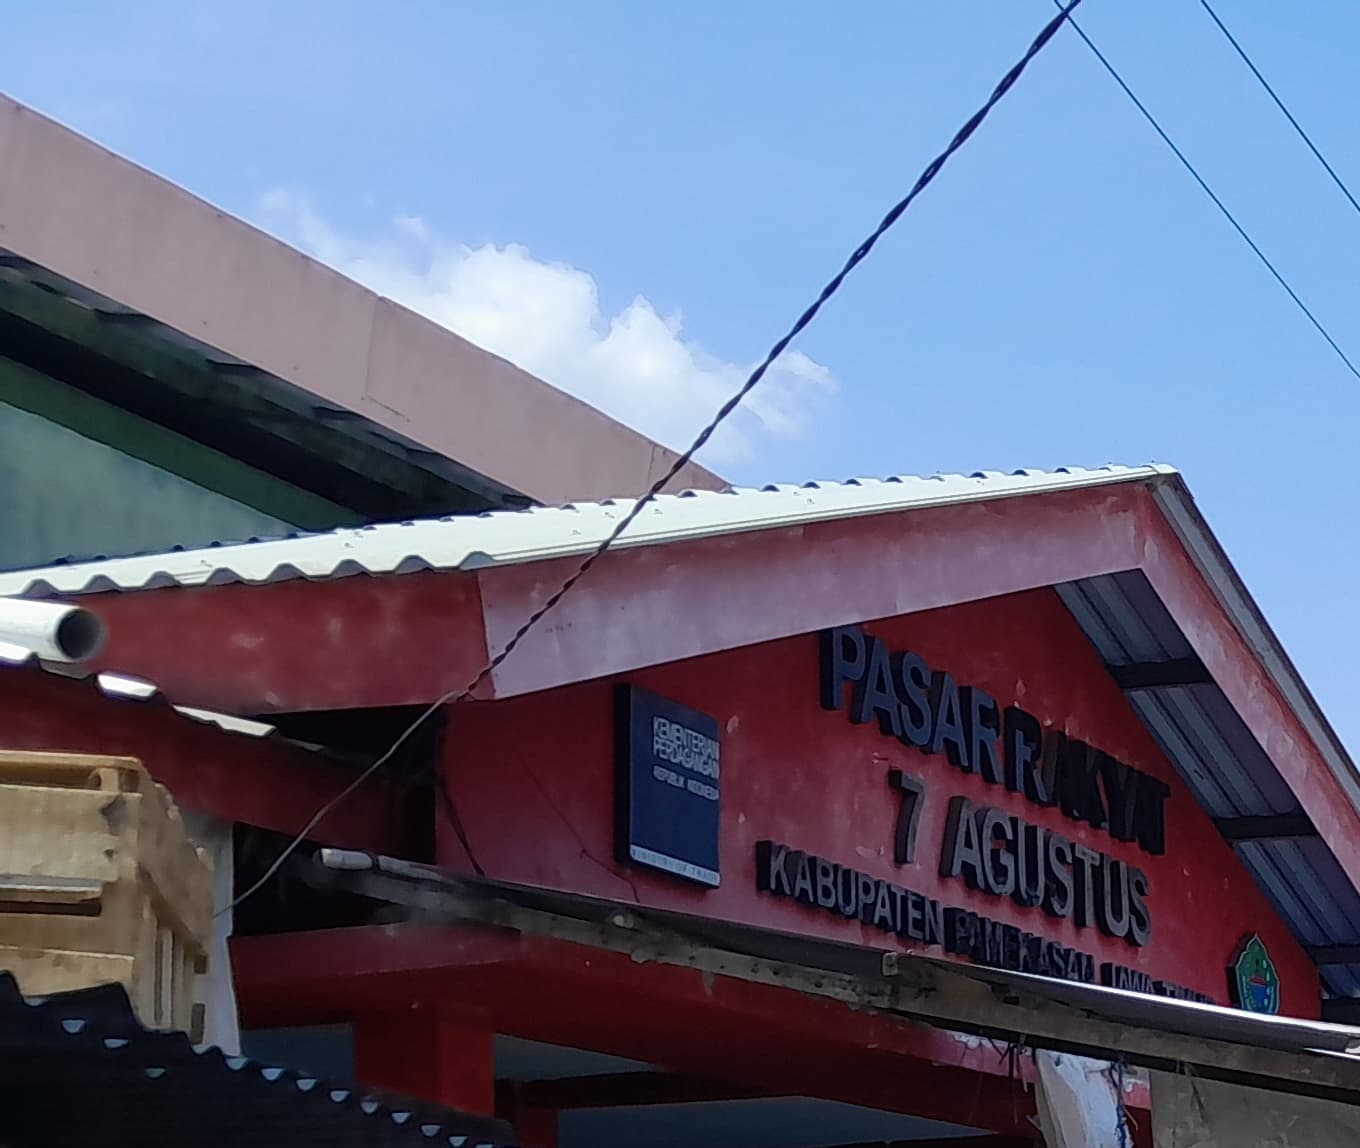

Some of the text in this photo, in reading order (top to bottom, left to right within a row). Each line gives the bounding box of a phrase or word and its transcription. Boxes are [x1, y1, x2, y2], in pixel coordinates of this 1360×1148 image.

[822, 625, 1000, 784] PASAR
[756, 840, 946, 945] KABUPATEN
[888, 767, 1152, 947] 7 AGUSTUS
